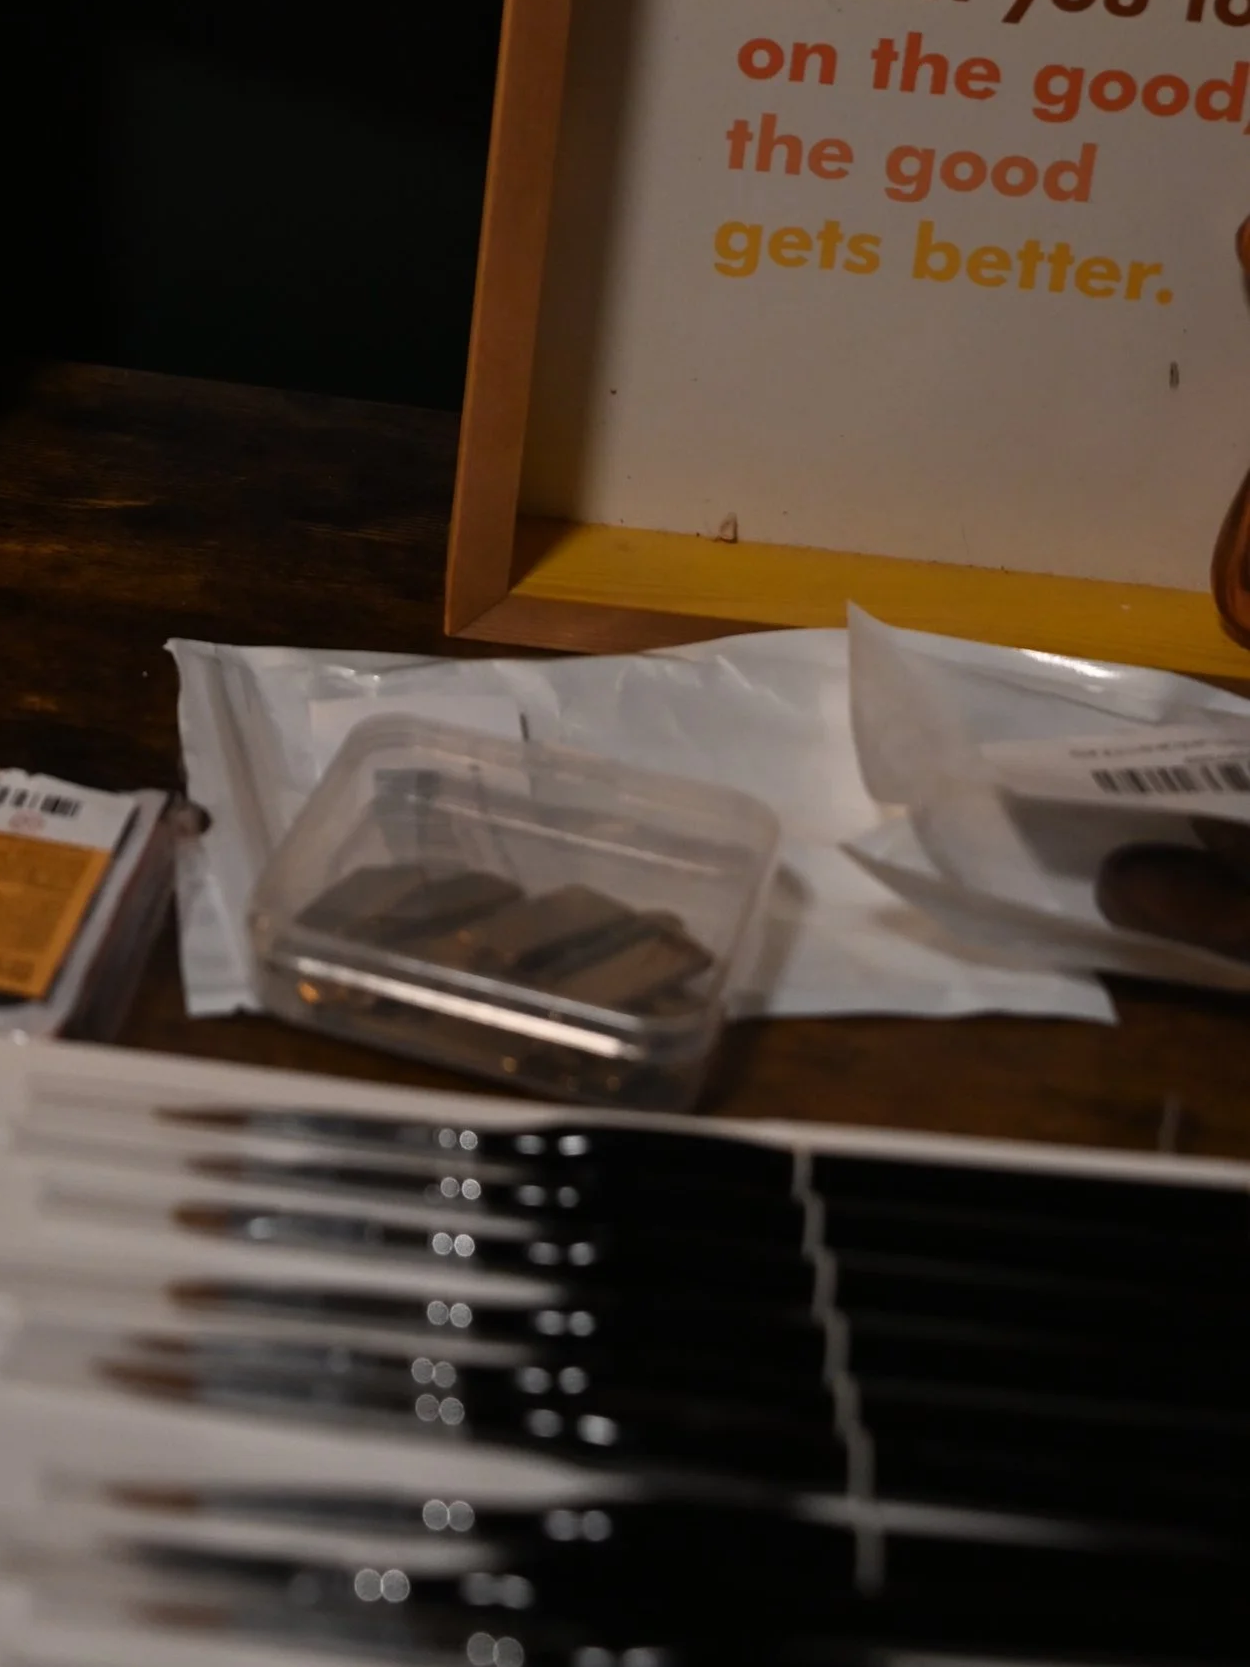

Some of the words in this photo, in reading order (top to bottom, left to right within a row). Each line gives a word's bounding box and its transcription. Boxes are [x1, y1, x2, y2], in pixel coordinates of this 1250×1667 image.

[737, 37, 838, 85] on
[871, 32, 1001, 100] the
[726, 113, 854, 180] the
[884, 142, 1098, 203] good
[713, 219, 882, 277] gets
[912, 220, 1173, 305] better.
